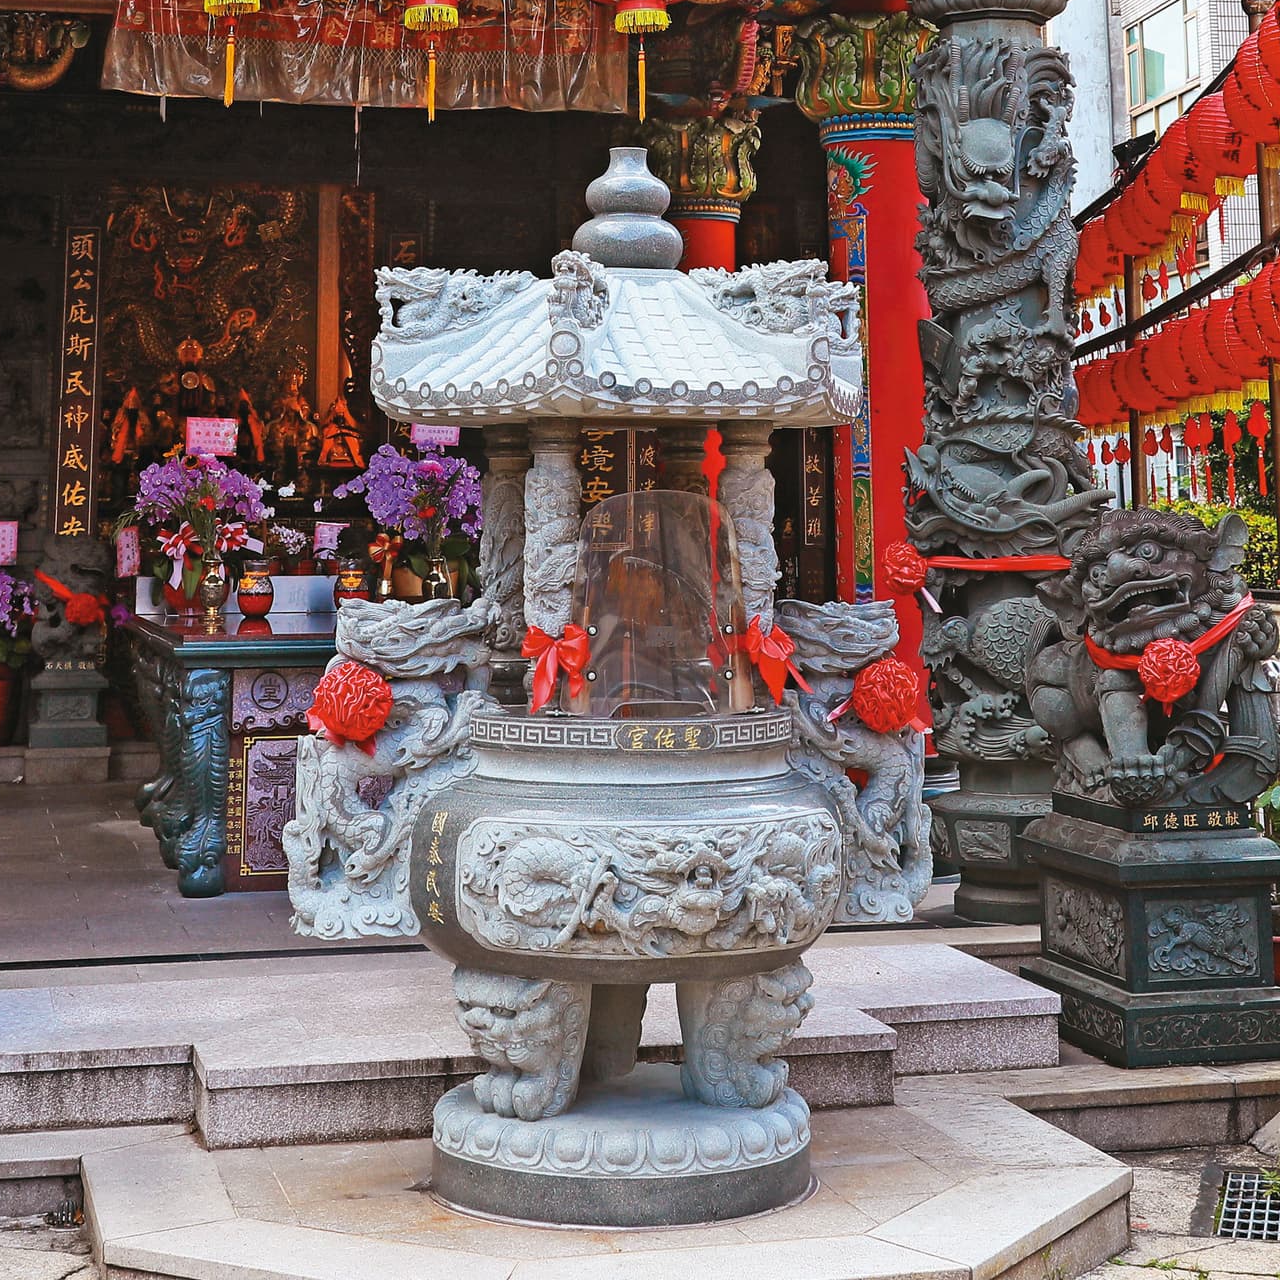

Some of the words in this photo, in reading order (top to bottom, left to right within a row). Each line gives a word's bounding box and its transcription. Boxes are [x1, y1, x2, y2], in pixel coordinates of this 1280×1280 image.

[626, 724, 703, 751] 聖佑宮
[1142, 811, 1200, 830] 邱德旺
[425, 810, 449, 925] 國泰民安
